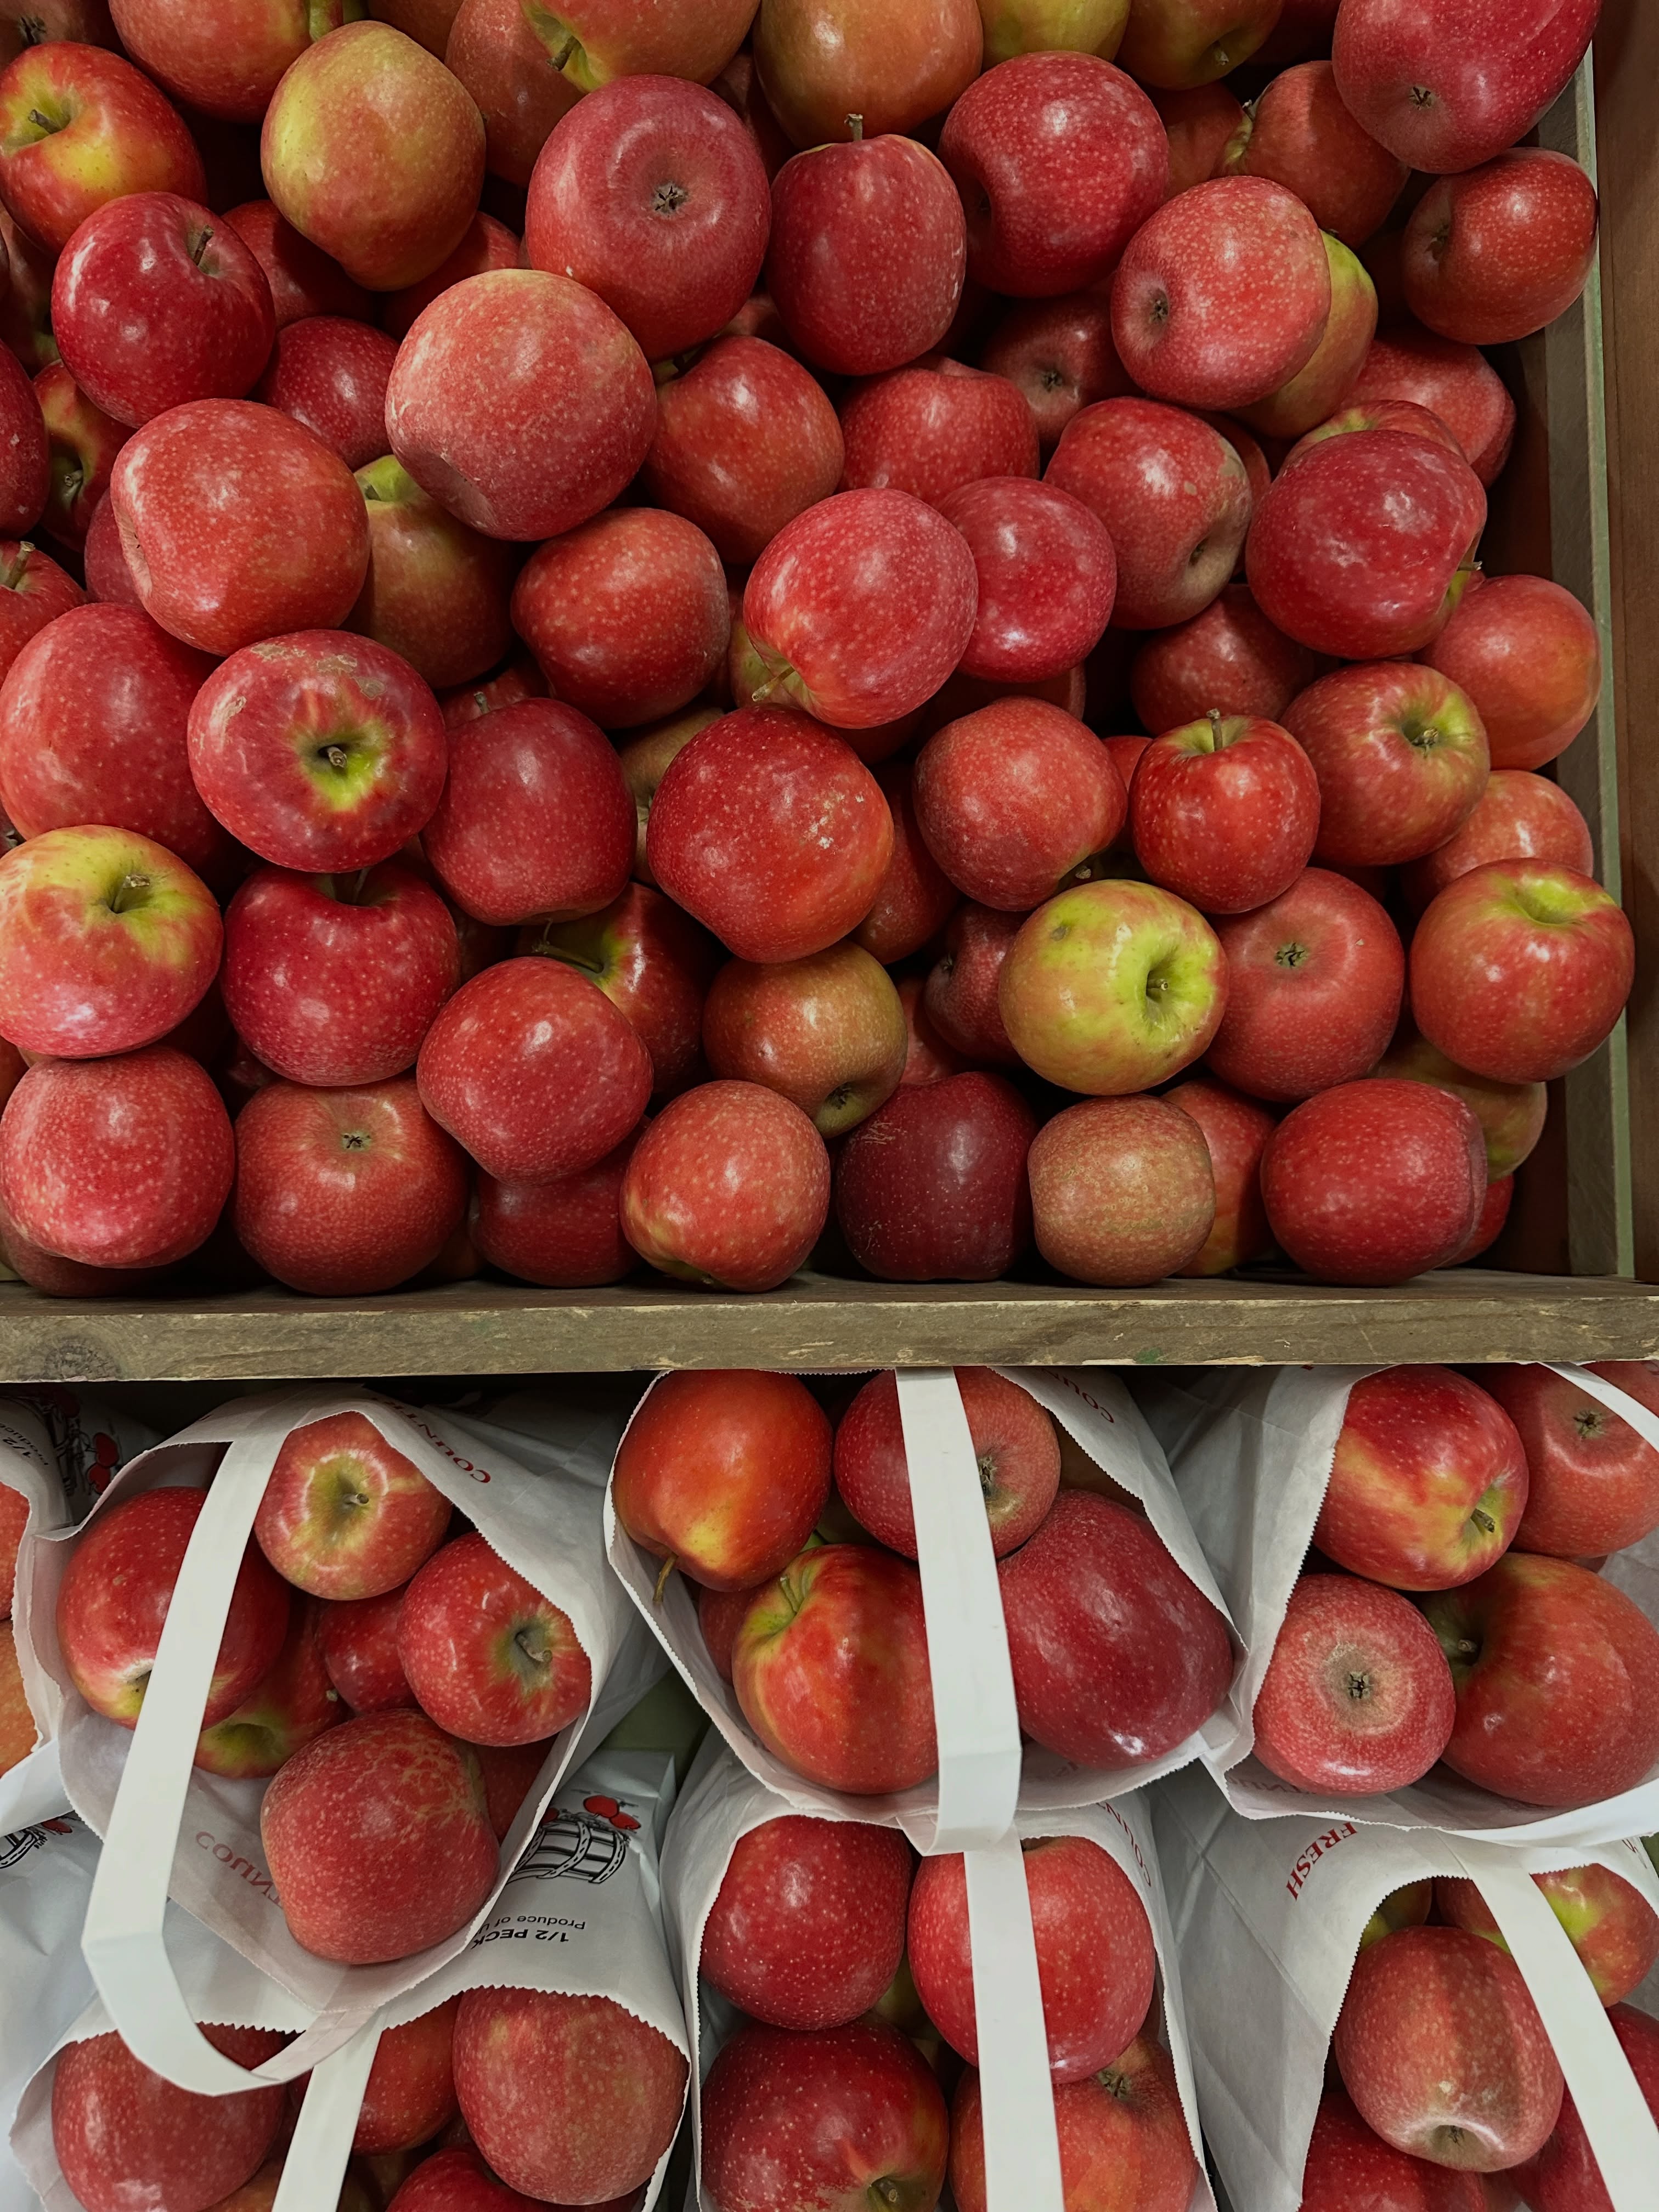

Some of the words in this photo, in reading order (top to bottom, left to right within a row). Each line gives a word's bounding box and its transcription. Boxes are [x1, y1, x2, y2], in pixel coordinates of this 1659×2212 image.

[1034, 1367, 1114, 1423] COUN
[1286, 1821, 1358, 1901] FRESH
[494, 1916, 511, 1927] of
[517, 1915, 586, 1930] Produce
[470, 1928, 528, 1949] PECK
[535, 1929, 569, 1942] 1/2
